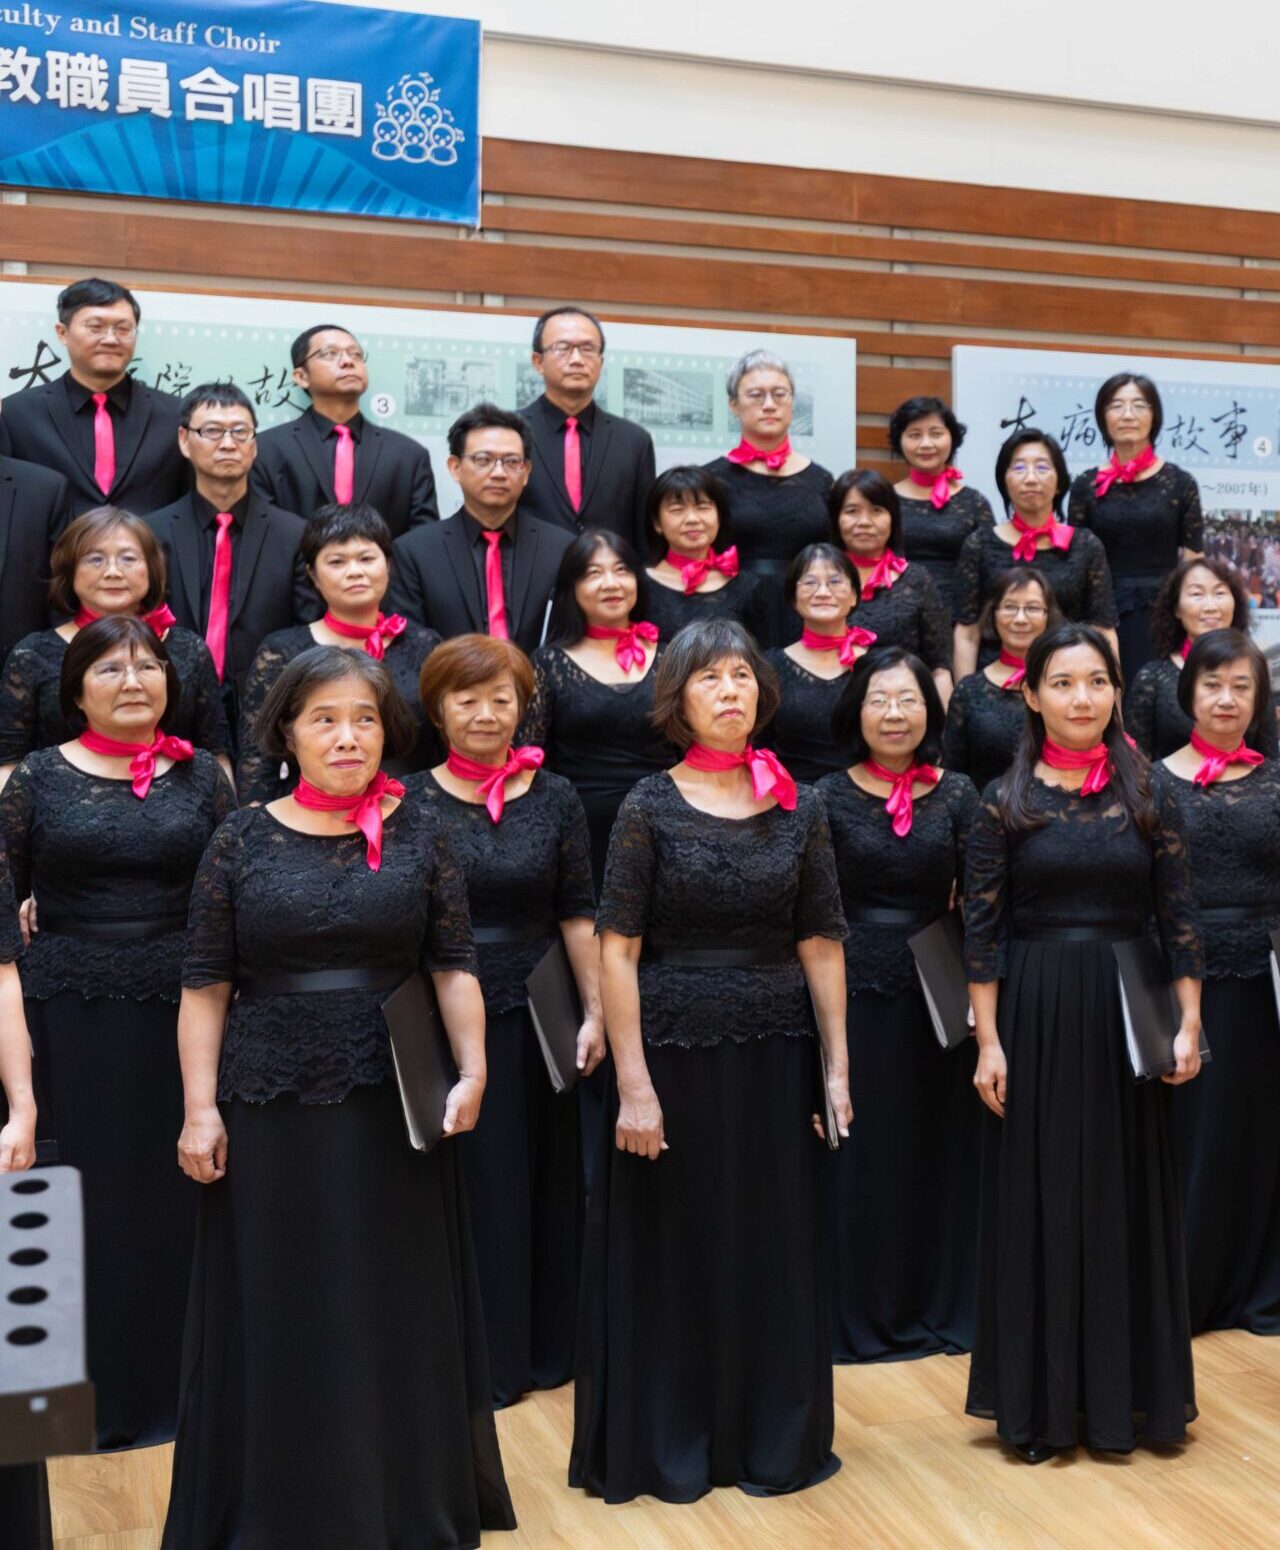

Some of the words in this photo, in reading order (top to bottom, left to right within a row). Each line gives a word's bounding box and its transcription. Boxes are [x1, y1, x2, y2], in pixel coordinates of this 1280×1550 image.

[70, 13, 120, 37] and
[129, 16, 198, 46] Staff
[204, 24, 281, 55] Choir
[0, 45, 363, 138] 教職員合唱團
